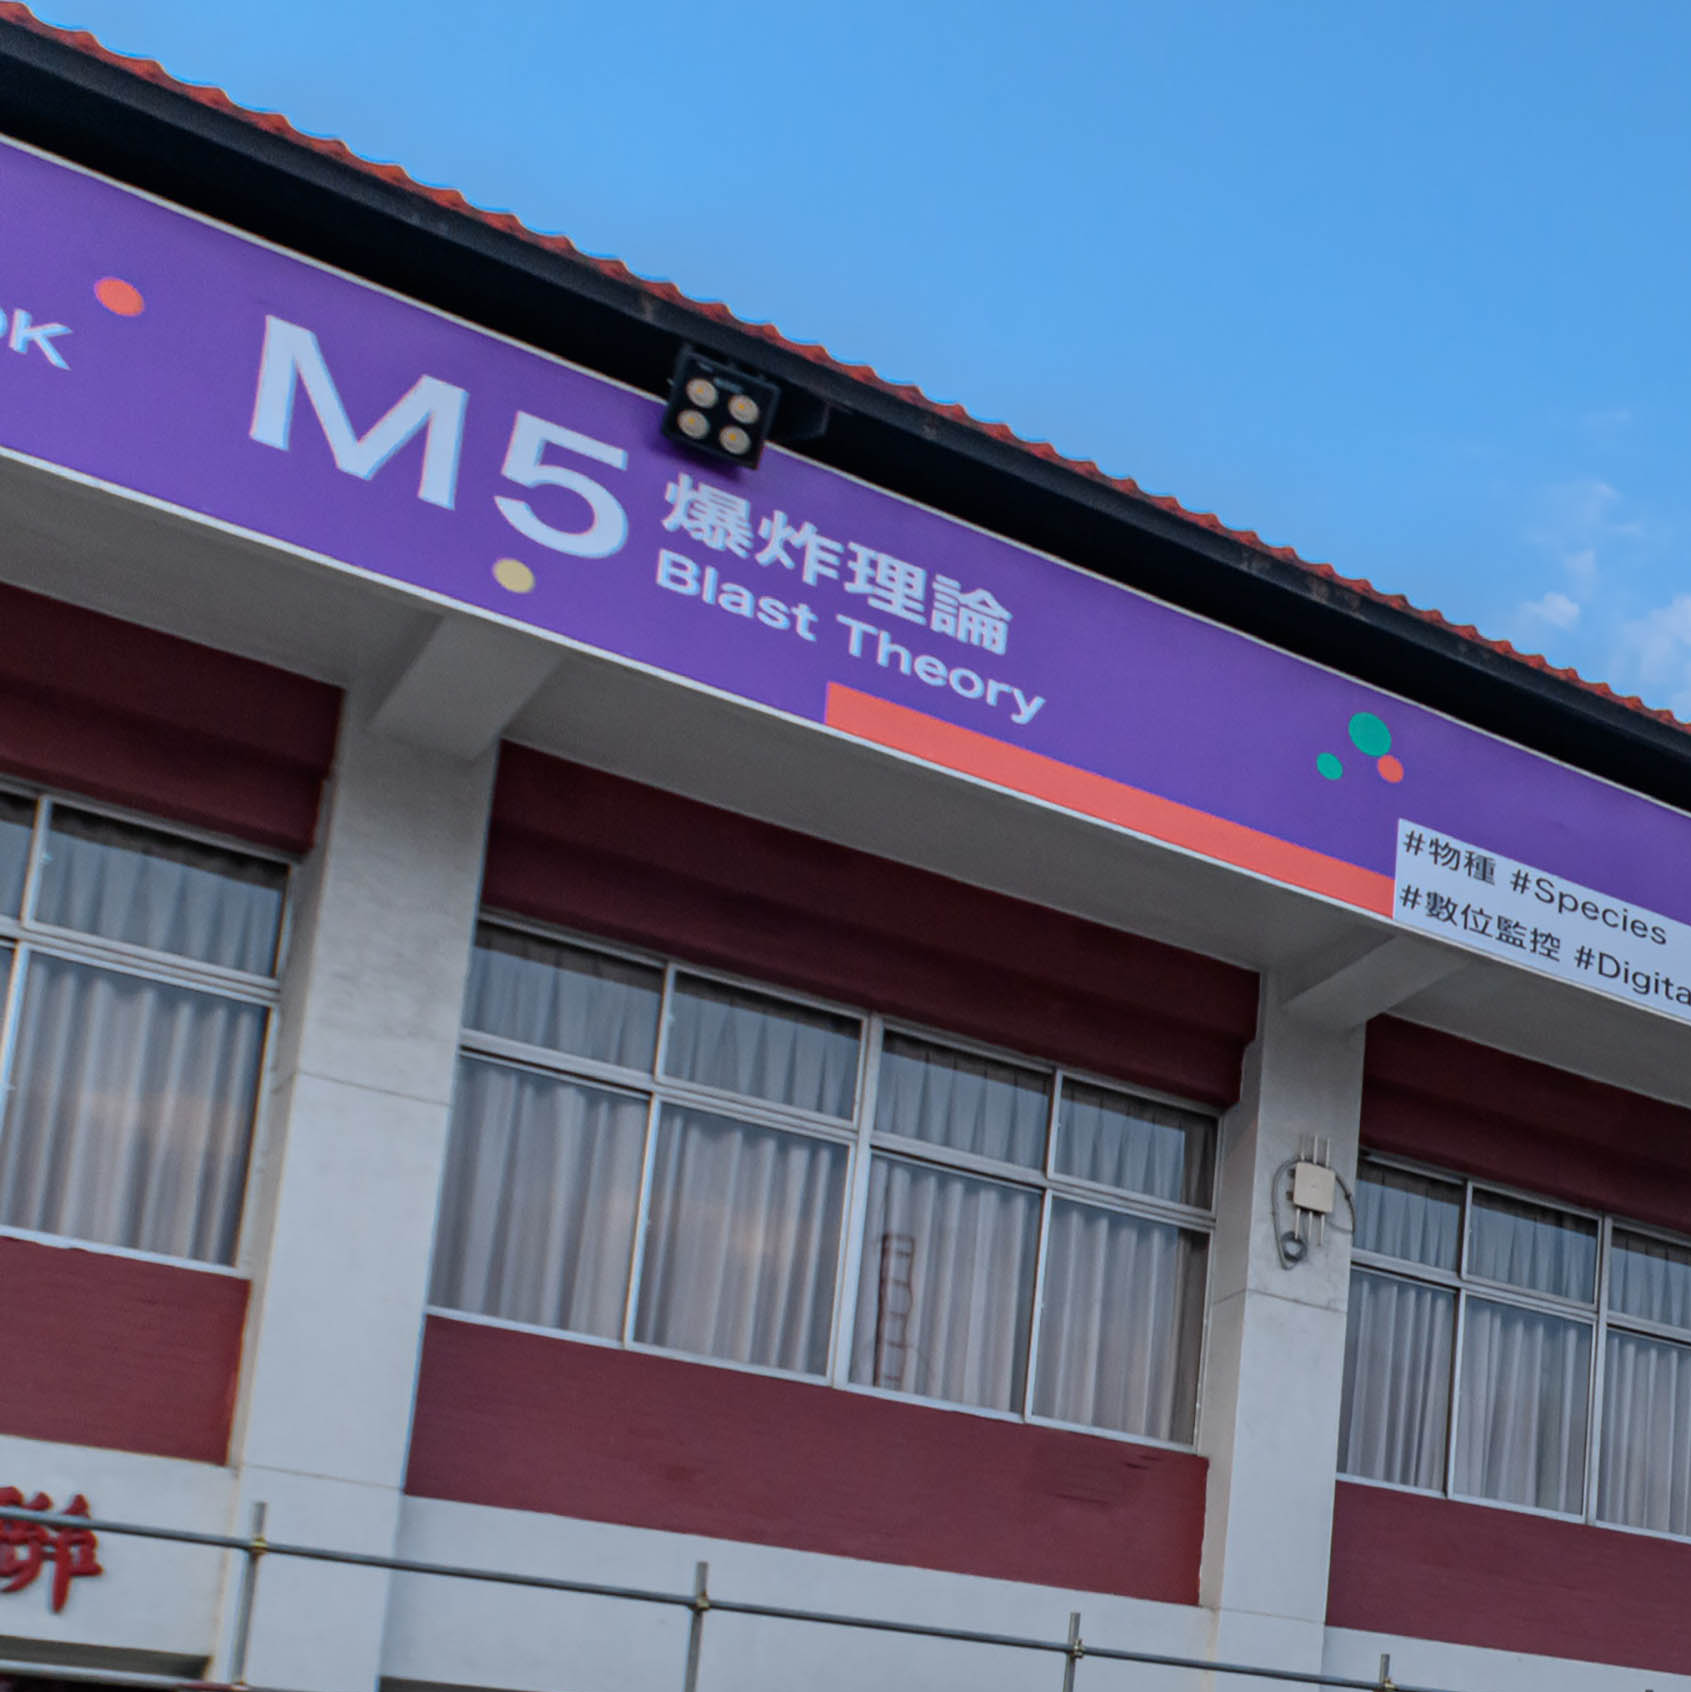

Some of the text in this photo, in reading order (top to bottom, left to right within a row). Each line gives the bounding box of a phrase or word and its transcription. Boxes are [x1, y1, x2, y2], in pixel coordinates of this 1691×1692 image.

[655, 548, 1046, 725] Blast Theory
[662, 473, 1013, 655] 爆炸理論
[1400, 884, 1561, 963] #數位監控
[1403, 830, 1496, 886] #物種
[1510, 869, 1667, 945] #Species
